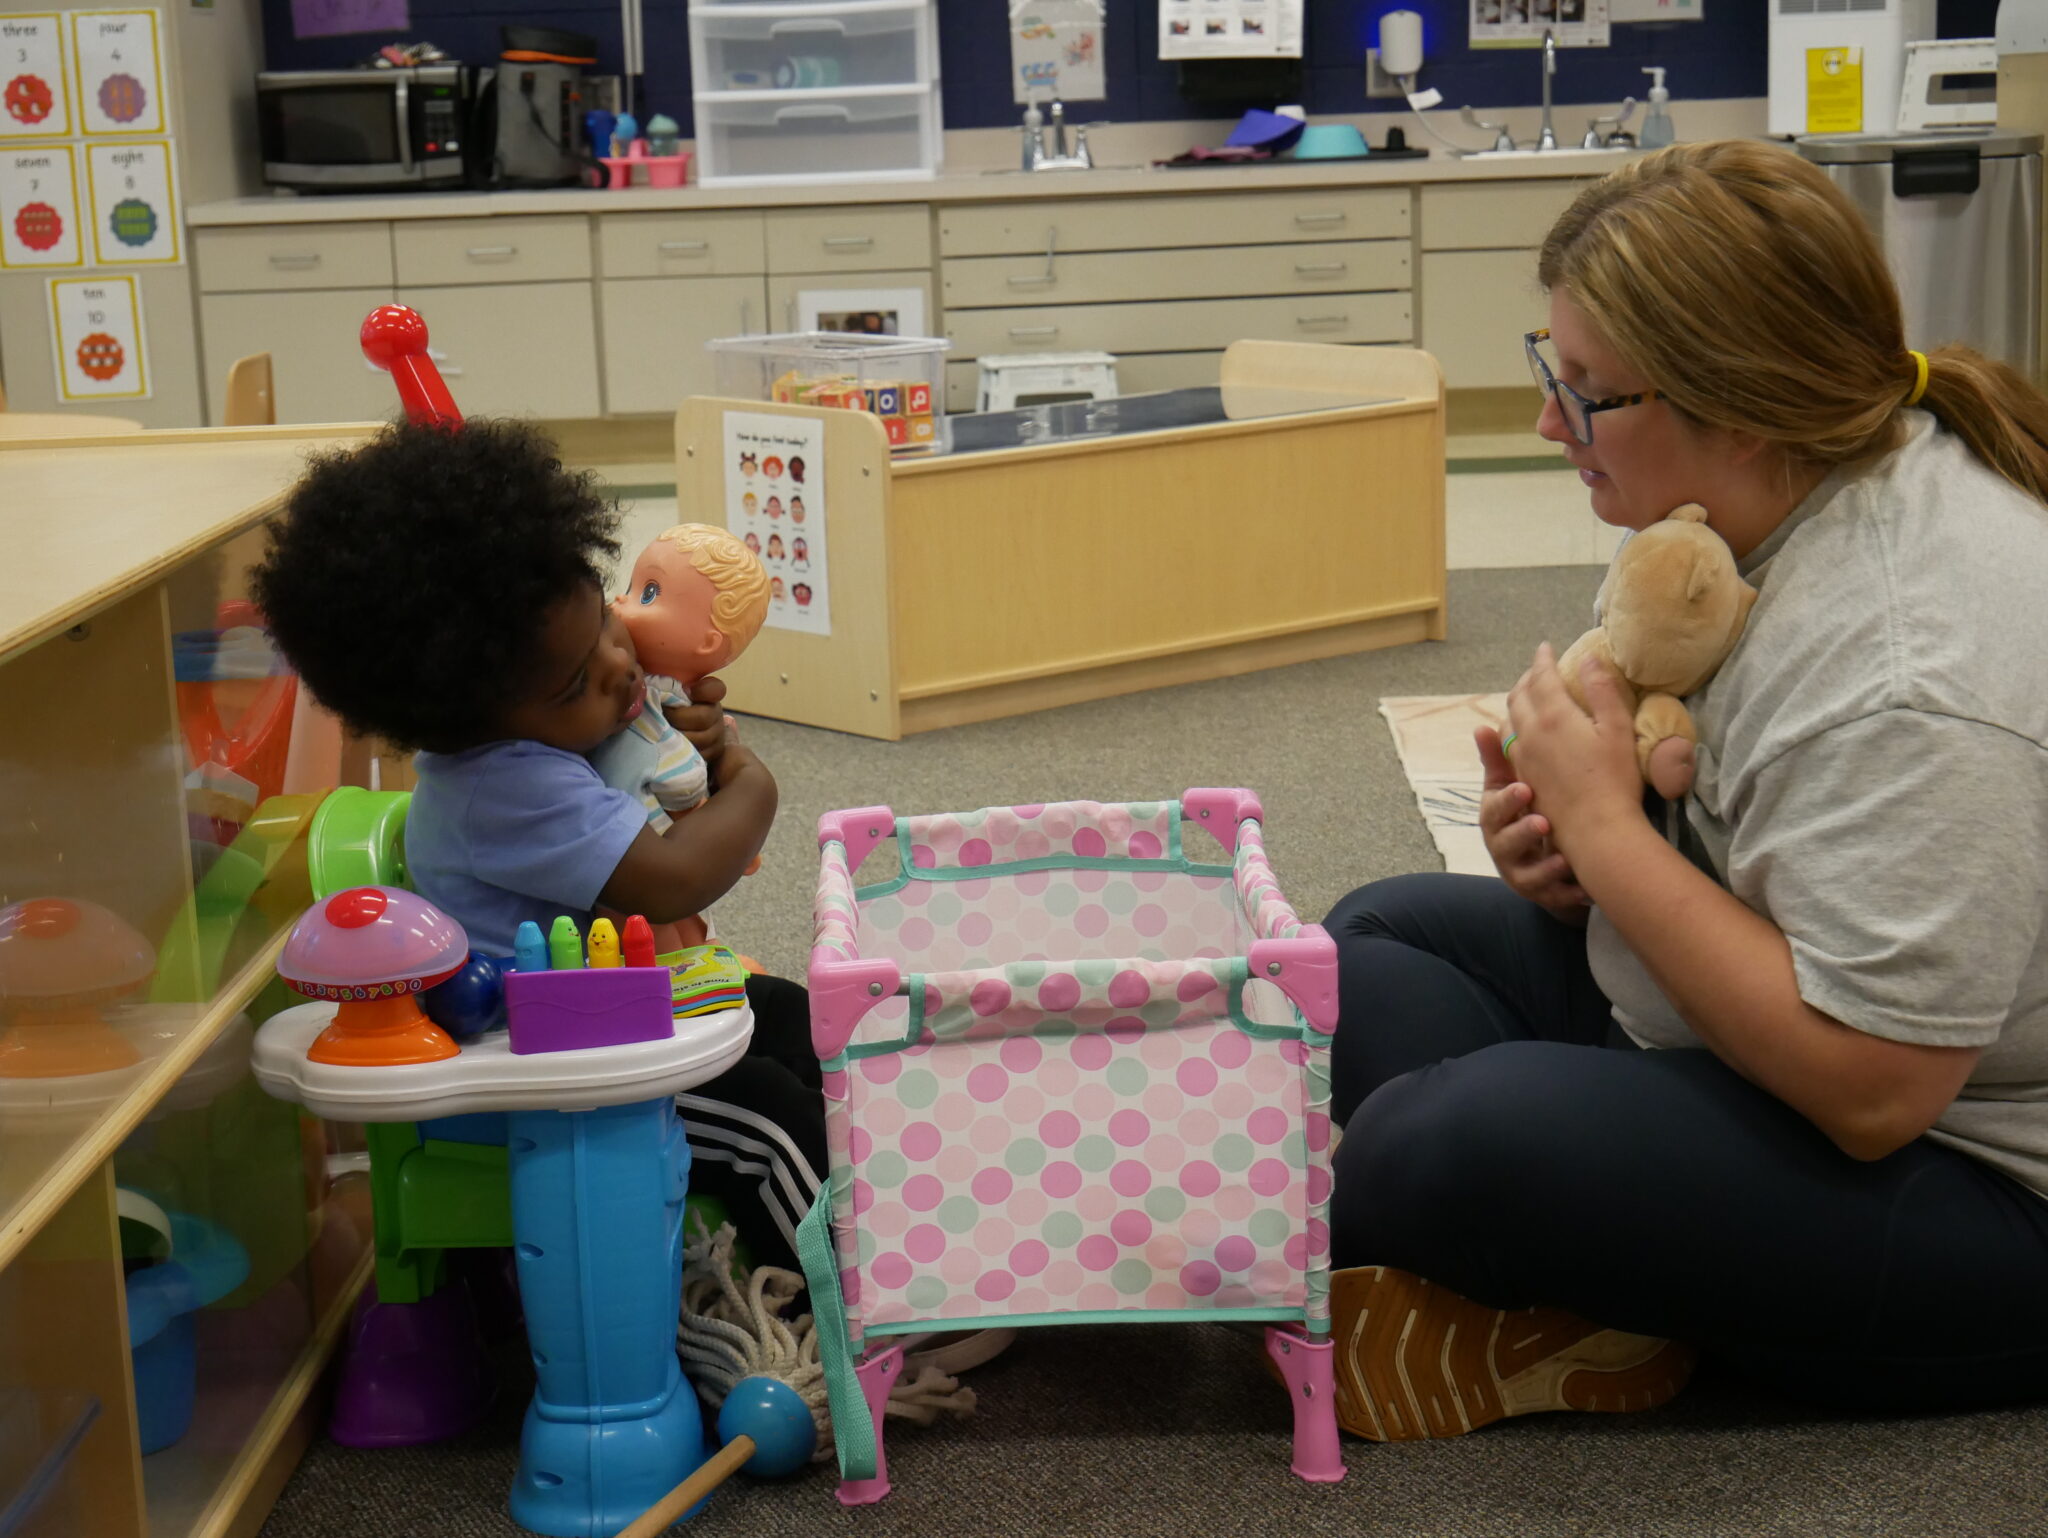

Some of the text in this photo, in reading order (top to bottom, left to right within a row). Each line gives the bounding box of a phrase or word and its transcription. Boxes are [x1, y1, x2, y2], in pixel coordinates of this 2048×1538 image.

[3, 21, 38, 36] three
[17, 48, 27, 62] 3
[110, 48, 121, 61] 4
[15, 157, 50, 168] seven
[111, 151, 144, 169] eight
[30, 179, 39, 192] 7
[88, 310, 106, 325] 10
